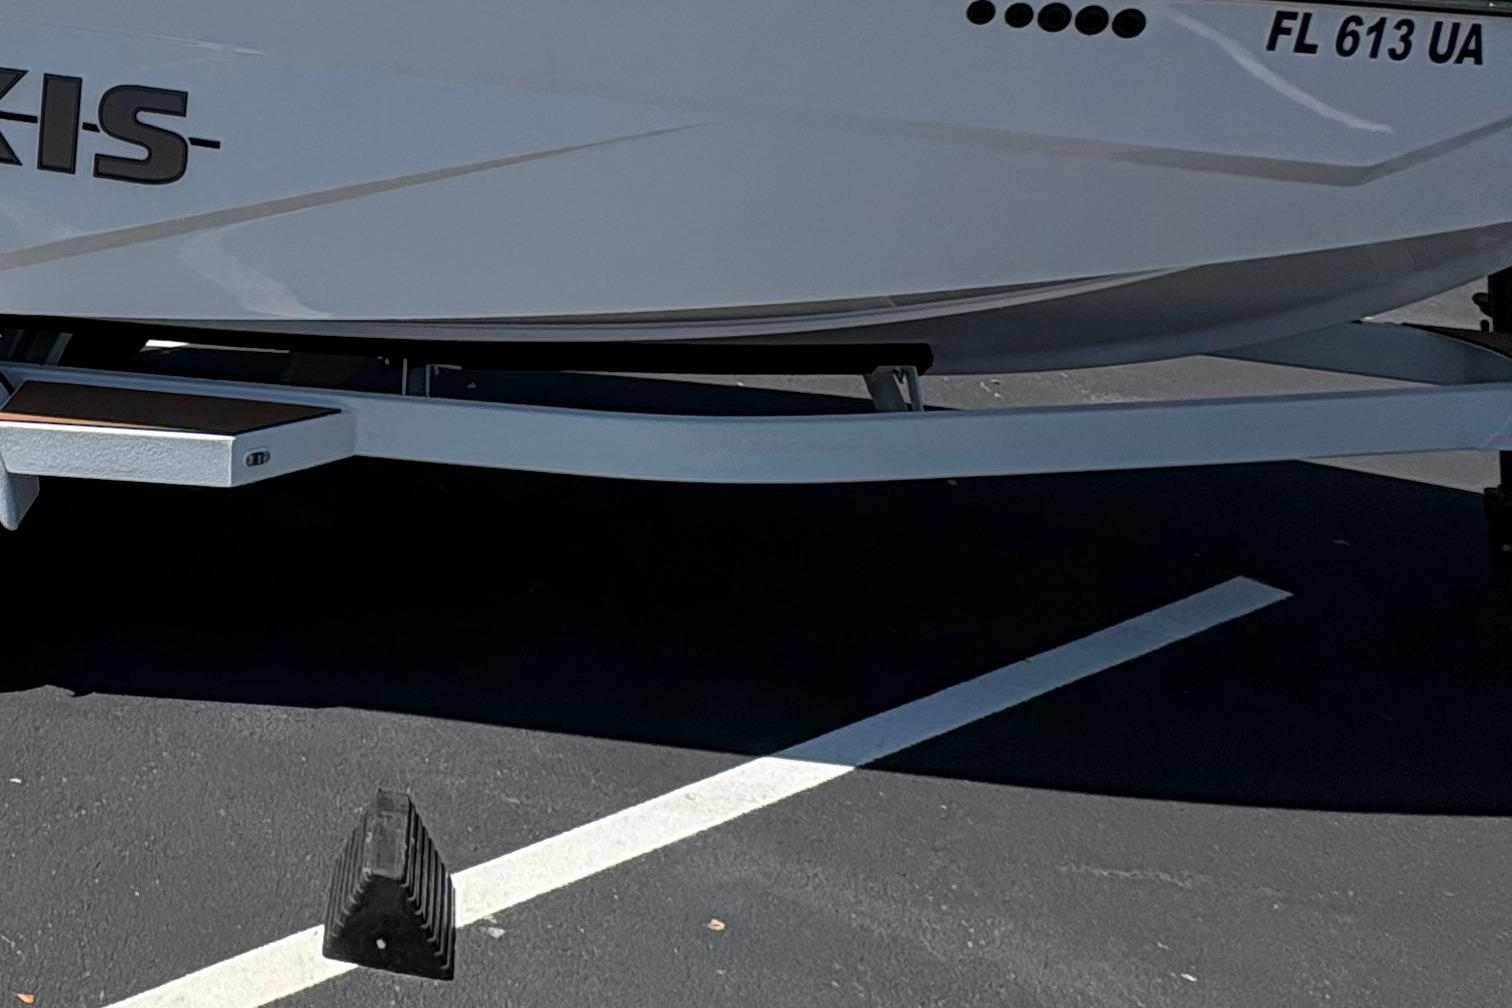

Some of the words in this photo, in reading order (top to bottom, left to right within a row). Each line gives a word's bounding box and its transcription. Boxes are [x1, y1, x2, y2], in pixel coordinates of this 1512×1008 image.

[1265, 10, 1319, 55] FL
[1335, 15, 1415, 61] 613
[1428, 21, 1483, 65] UA
